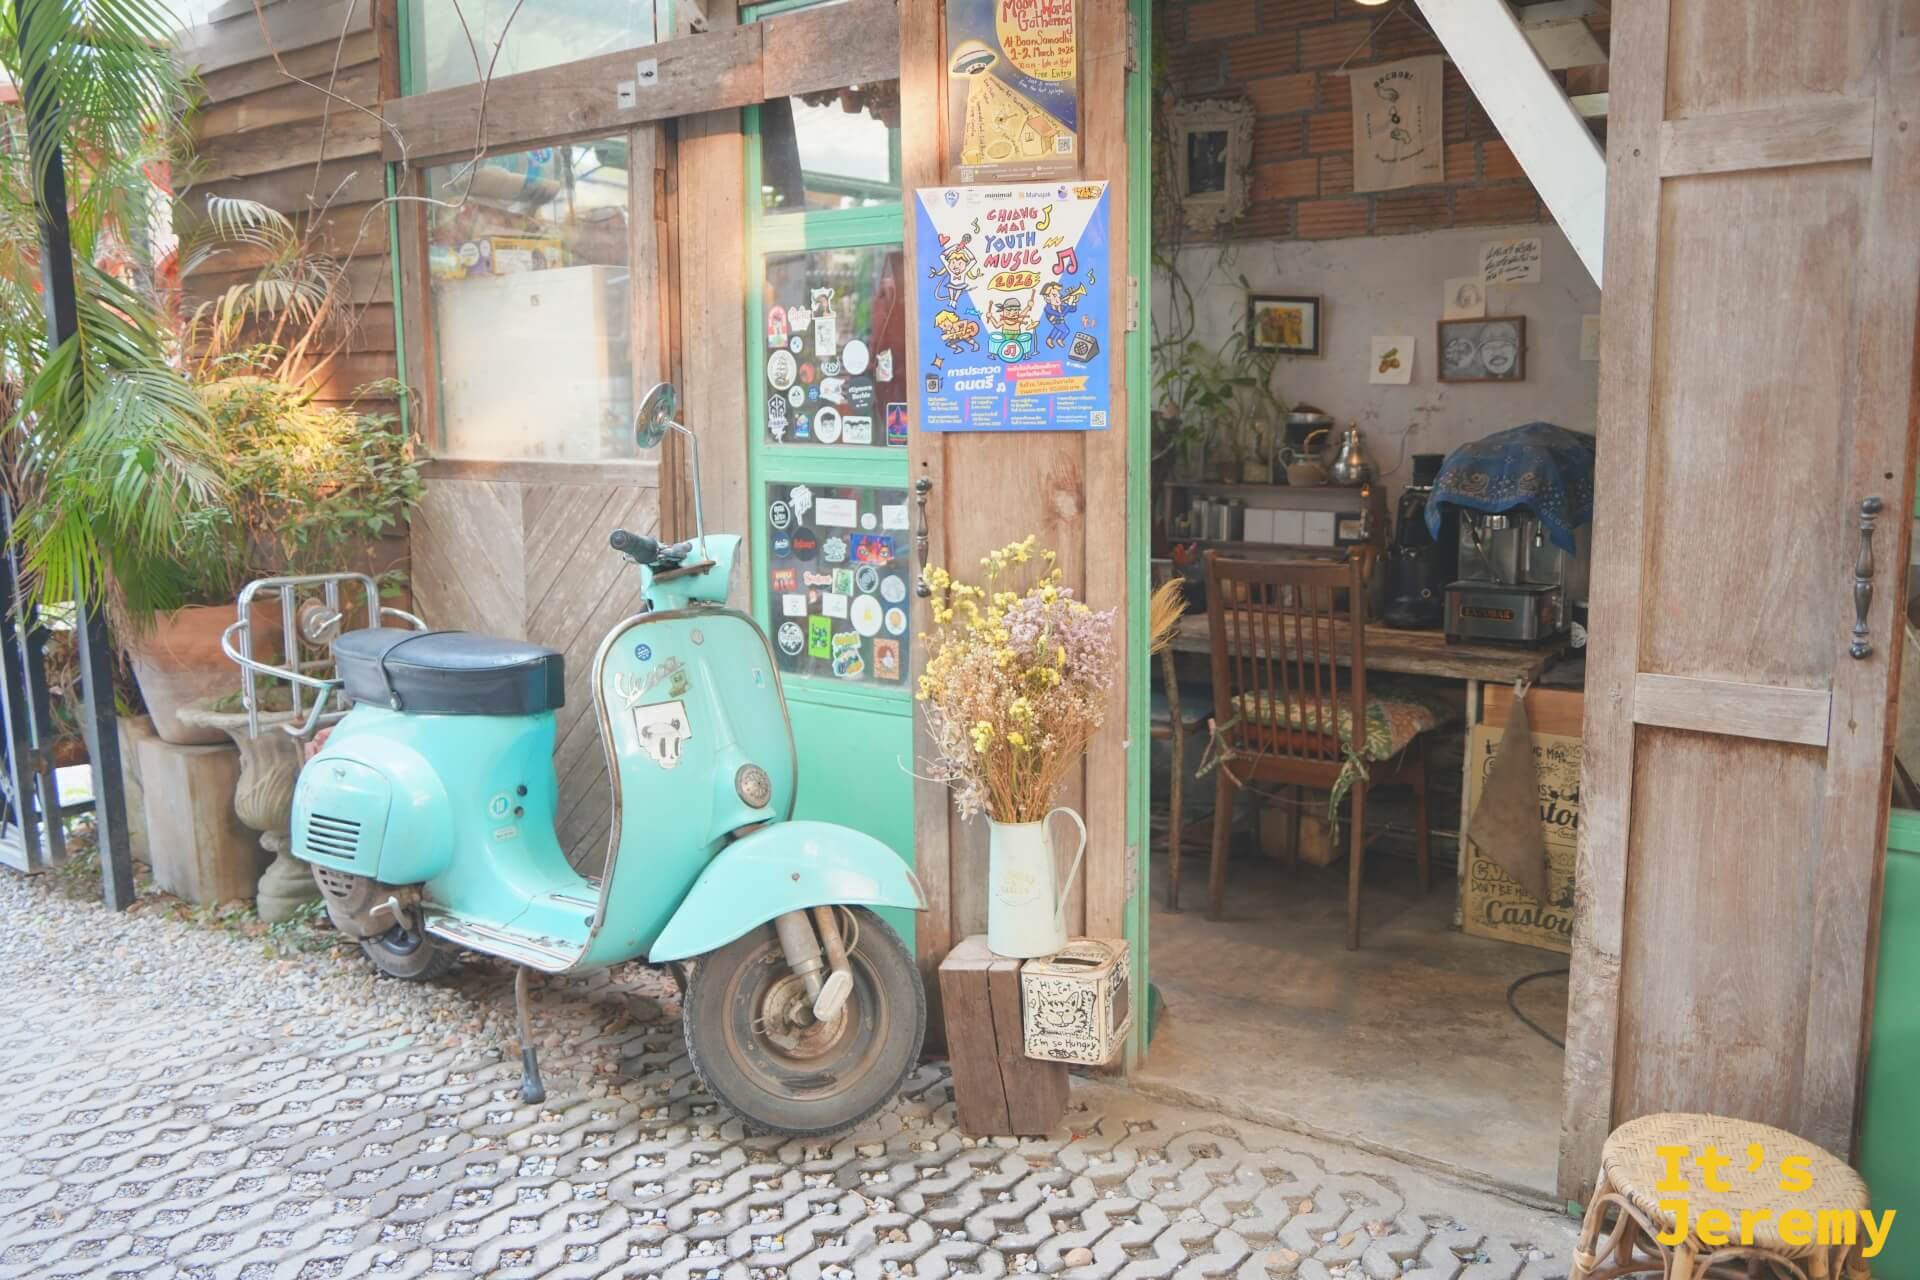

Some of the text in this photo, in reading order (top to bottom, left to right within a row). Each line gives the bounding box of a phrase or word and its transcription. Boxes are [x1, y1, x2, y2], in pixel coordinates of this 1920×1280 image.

[1033, 44, 1055, 58] March
[1034, 68, 1072, 79] Free Entry
[986, 207, 1038, 222] CHIANG
[996, 220, 1026, 234] MAI
[984, 231, 1036, 253] YOUTH
[983, 249, 1042, 271] MUSIC
[994, 273, 1033, 287] 2026
[954, 375, 994, 392] ดนตรี
[1065, 1039, 1097, 1053] Hungry
